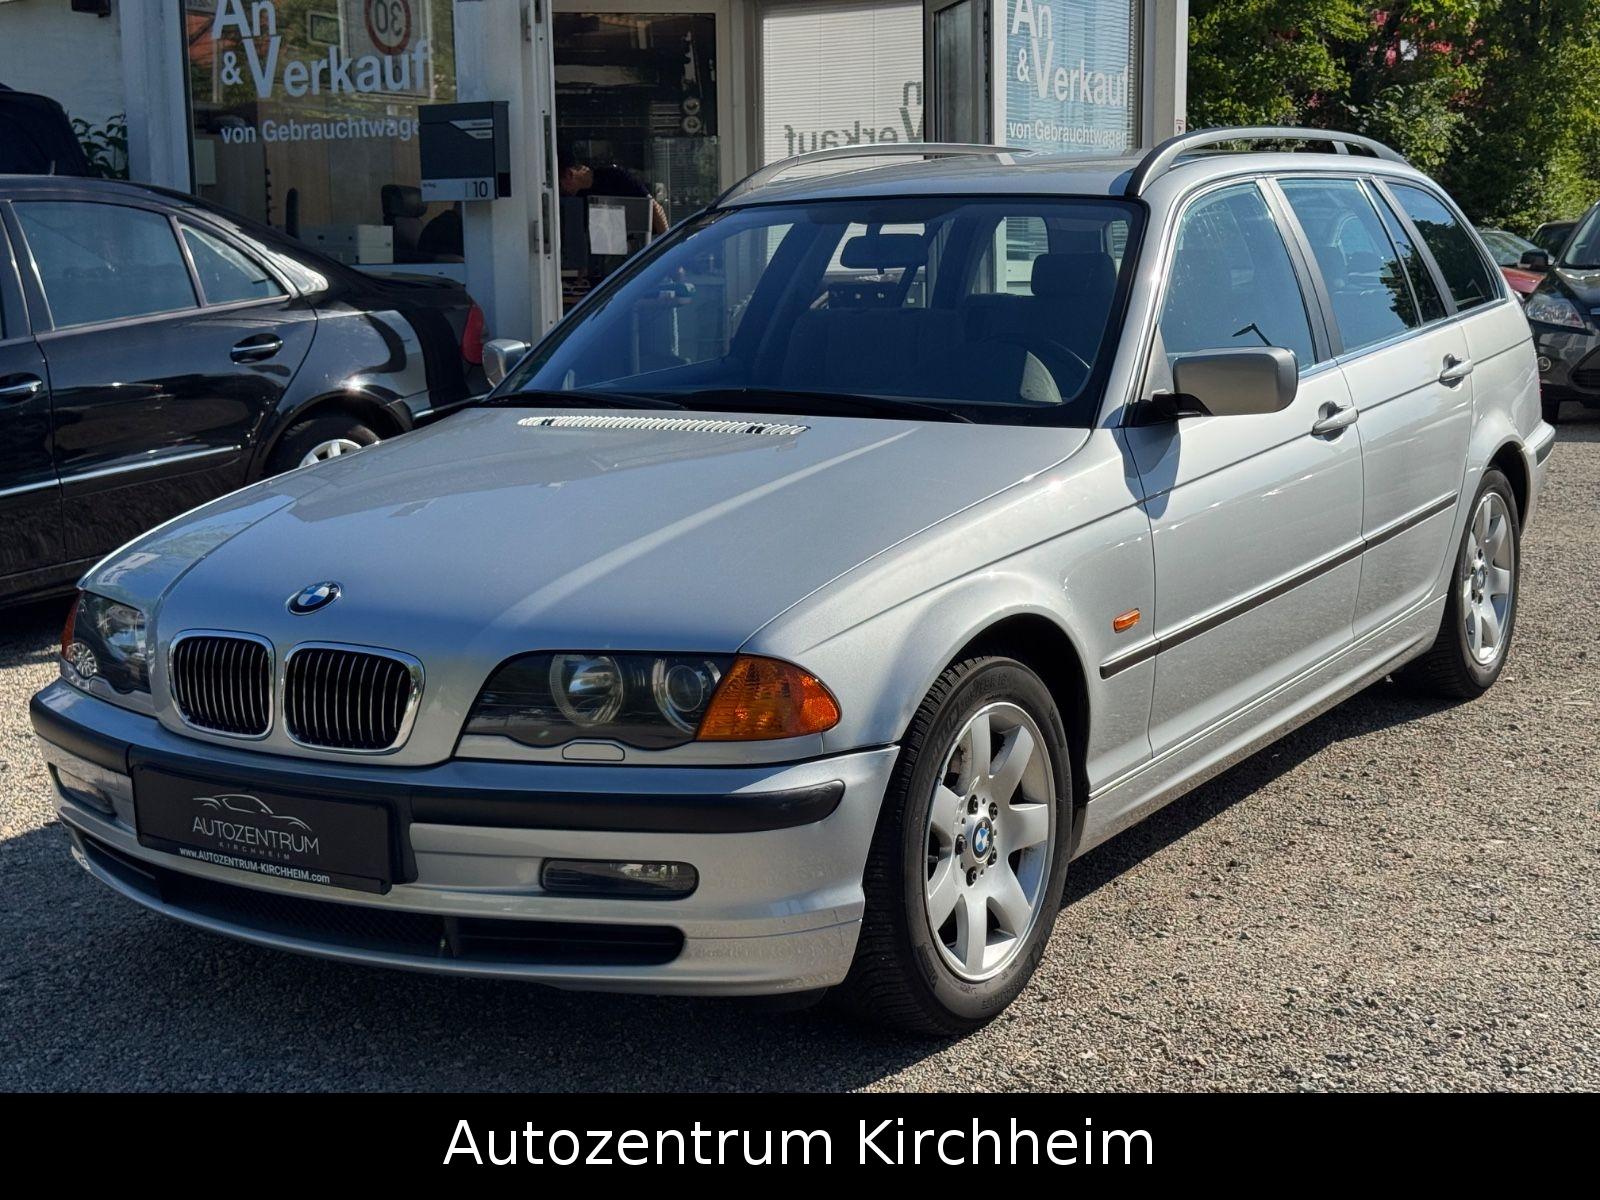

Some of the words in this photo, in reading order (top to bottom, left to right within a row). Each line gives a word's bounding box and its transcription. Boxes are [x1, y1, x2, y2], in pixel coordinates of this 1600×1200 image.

[212, 0, 277, 39] An
[1011, 0, 1052, 39] An
[221, 51, 243, 85] &
[243, 36, 429, 98] Verkauf
[1017, 48, 1030, 82] &
[1032, 38, 1129, 107] Verkauf
[221, 126, 256, 144] von
[262, 118, 419, 142] Gebrauchtwage
[1009, 121, 1031, 139] von
[1034, 119, 1127, 149] Gebrauchtwagen
[473, 180, 489, 198] 10
[192, 816, 320, 855] AUTOZENTRUM
[179, 847, 330, 884] www.AUTOZENTRUM-KIRCHHEIM.com
